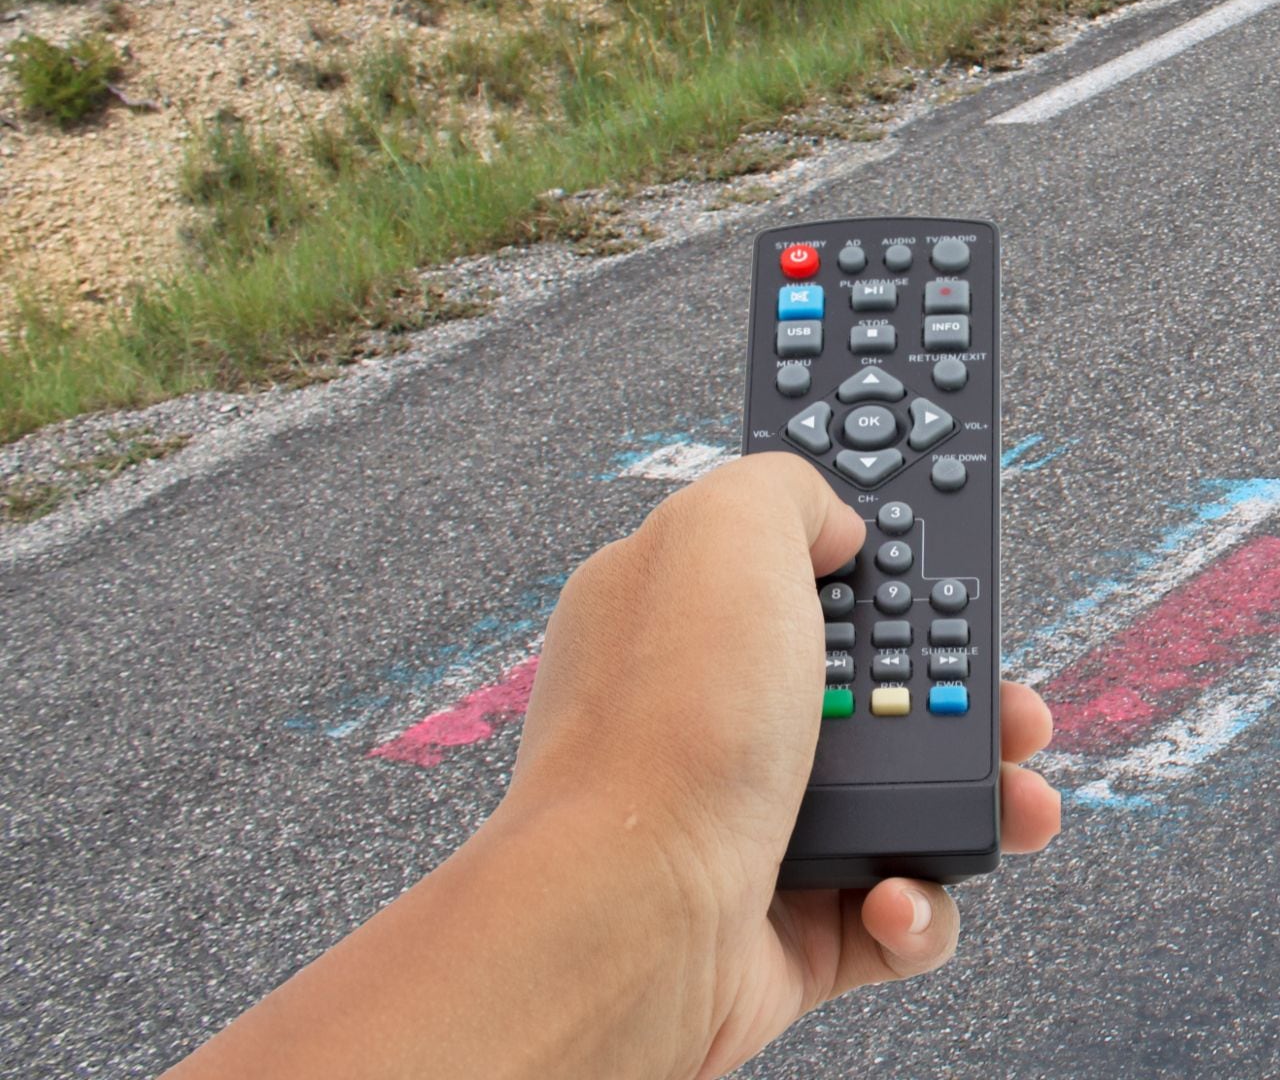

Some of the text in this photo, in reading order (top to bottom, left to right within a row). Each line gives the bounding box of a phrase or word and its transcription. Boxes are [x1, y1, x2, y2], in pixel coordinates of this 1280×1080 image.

[845, 239, 861, 248] AD
[881, 237, 917, 246] AUDIO
[858, 319, 889, 327] STOP
[932, 322, 960, 331] INFO
[787, 327, 812, 336] USB
[861, 357, 883, 365] CH+
[908, 352, 988, 362] RETURN/EXIT
[776, 358, 812, 369] MENU
[858, 416, 881, 427] OK
[964, 422, 989, 430] VOL+
[753, 430, 776, 439] VOL-
[932, 454, 987, 462] PAGE DOWN
[858, 494, 879, 503] CH-
[891, 507, 900, 518] 3
[890, 546, 899, 557] 6
[831, 588, 841, 599] 8
[889, 586, 898, 597] 9
[943, 585, 953, 595] 0
[879, 648, 908, 656] TEXT
